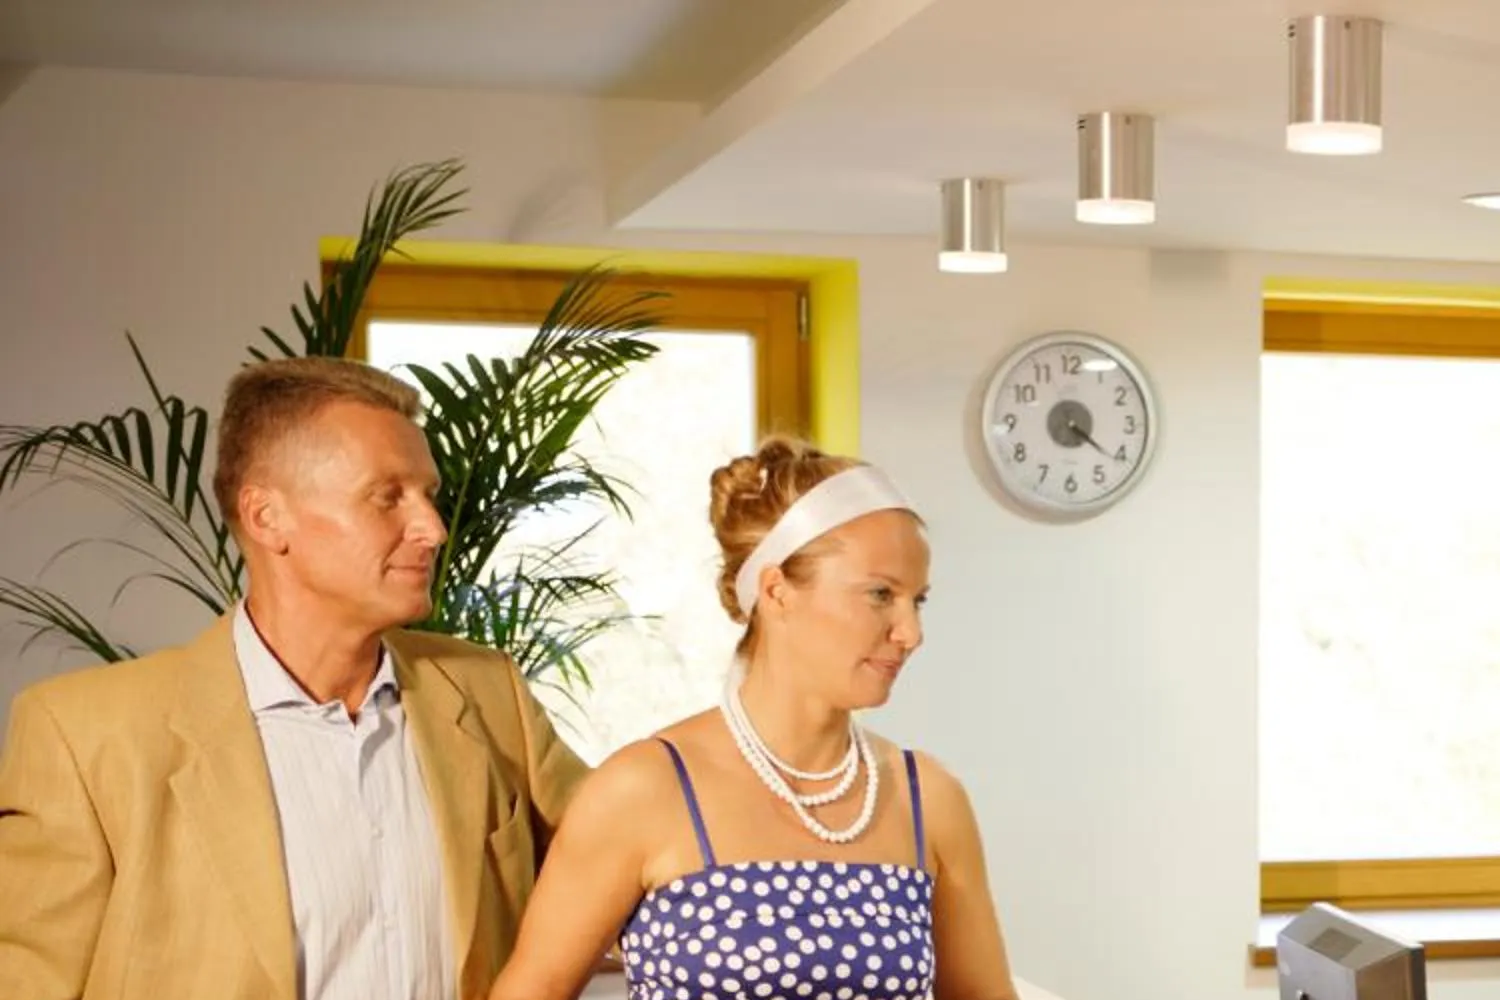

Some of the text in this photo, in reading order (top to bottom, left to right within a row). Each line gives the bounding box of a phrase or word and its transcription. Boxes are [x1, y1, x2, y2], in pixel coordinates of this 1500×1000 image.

[1034, 363, 1051, 384] 11
[1061, 355, 1082, 375] 12
[1014, 384, 1036, 404] 10
[1115, 386, 1127, 406] 2
[1004, 413, 1017, 433] 9
[1124, 415, 1136, 435] 3
[1014, 442, 1027, 463] 8
[1114, 445, 1126, 461] 4
[1038, 464, 1050, 484] 7
[1064, 473, 1078, 493] 6
[1093, 465, 1105, 485] 5
